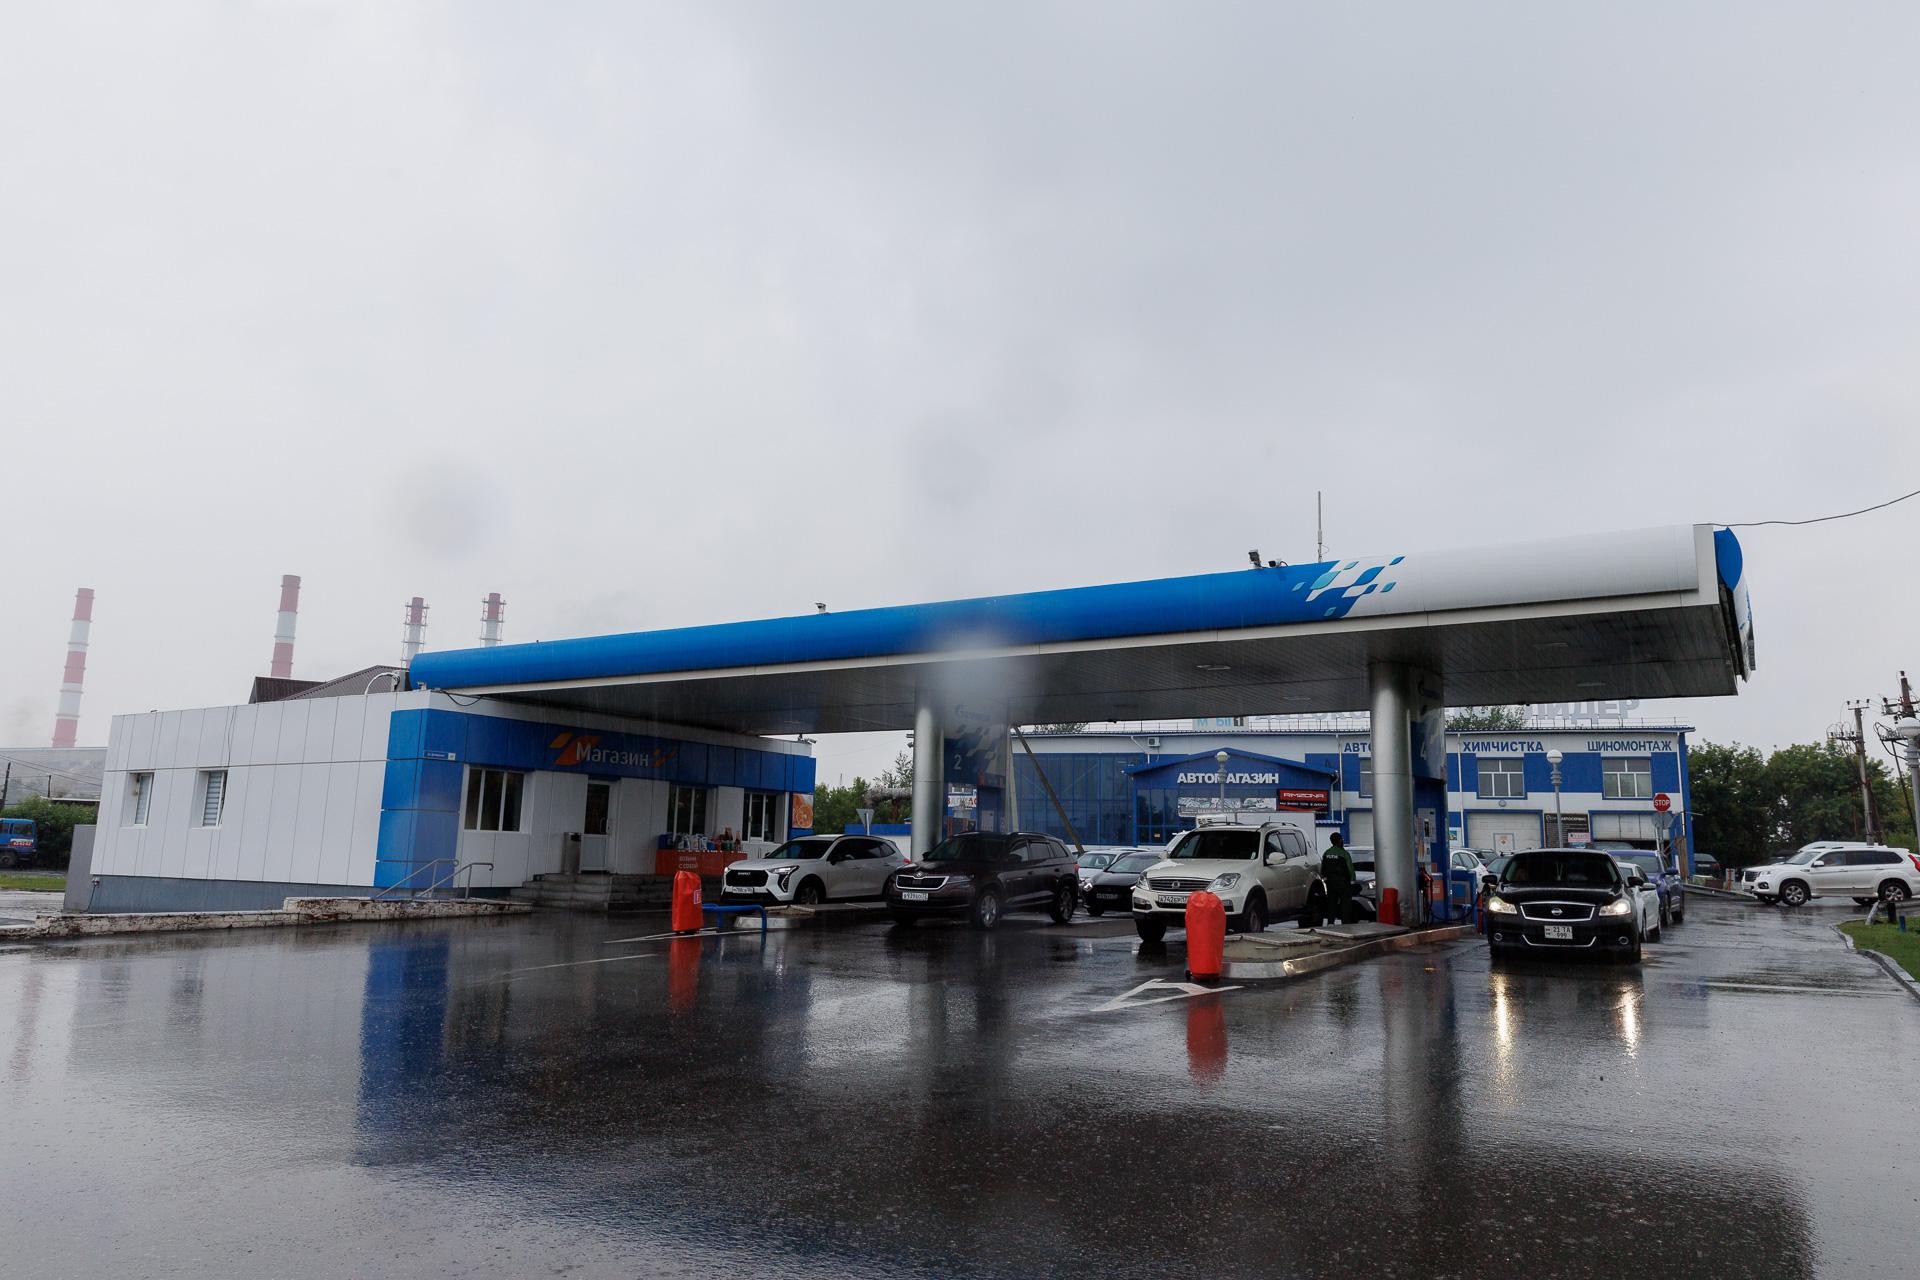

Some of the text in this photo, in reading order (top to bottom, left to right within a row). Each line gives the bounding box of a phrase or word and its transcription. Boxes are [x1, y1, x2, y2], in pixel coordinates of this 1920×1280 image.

[1463, 741, 1544, 752] ХИМЧИСТКА
[1587, 740, 1672, 752] ШИНОМОНТАЖ
[576, 741, 649, 768] Магазин
[953, 753, 962, 770] 2
